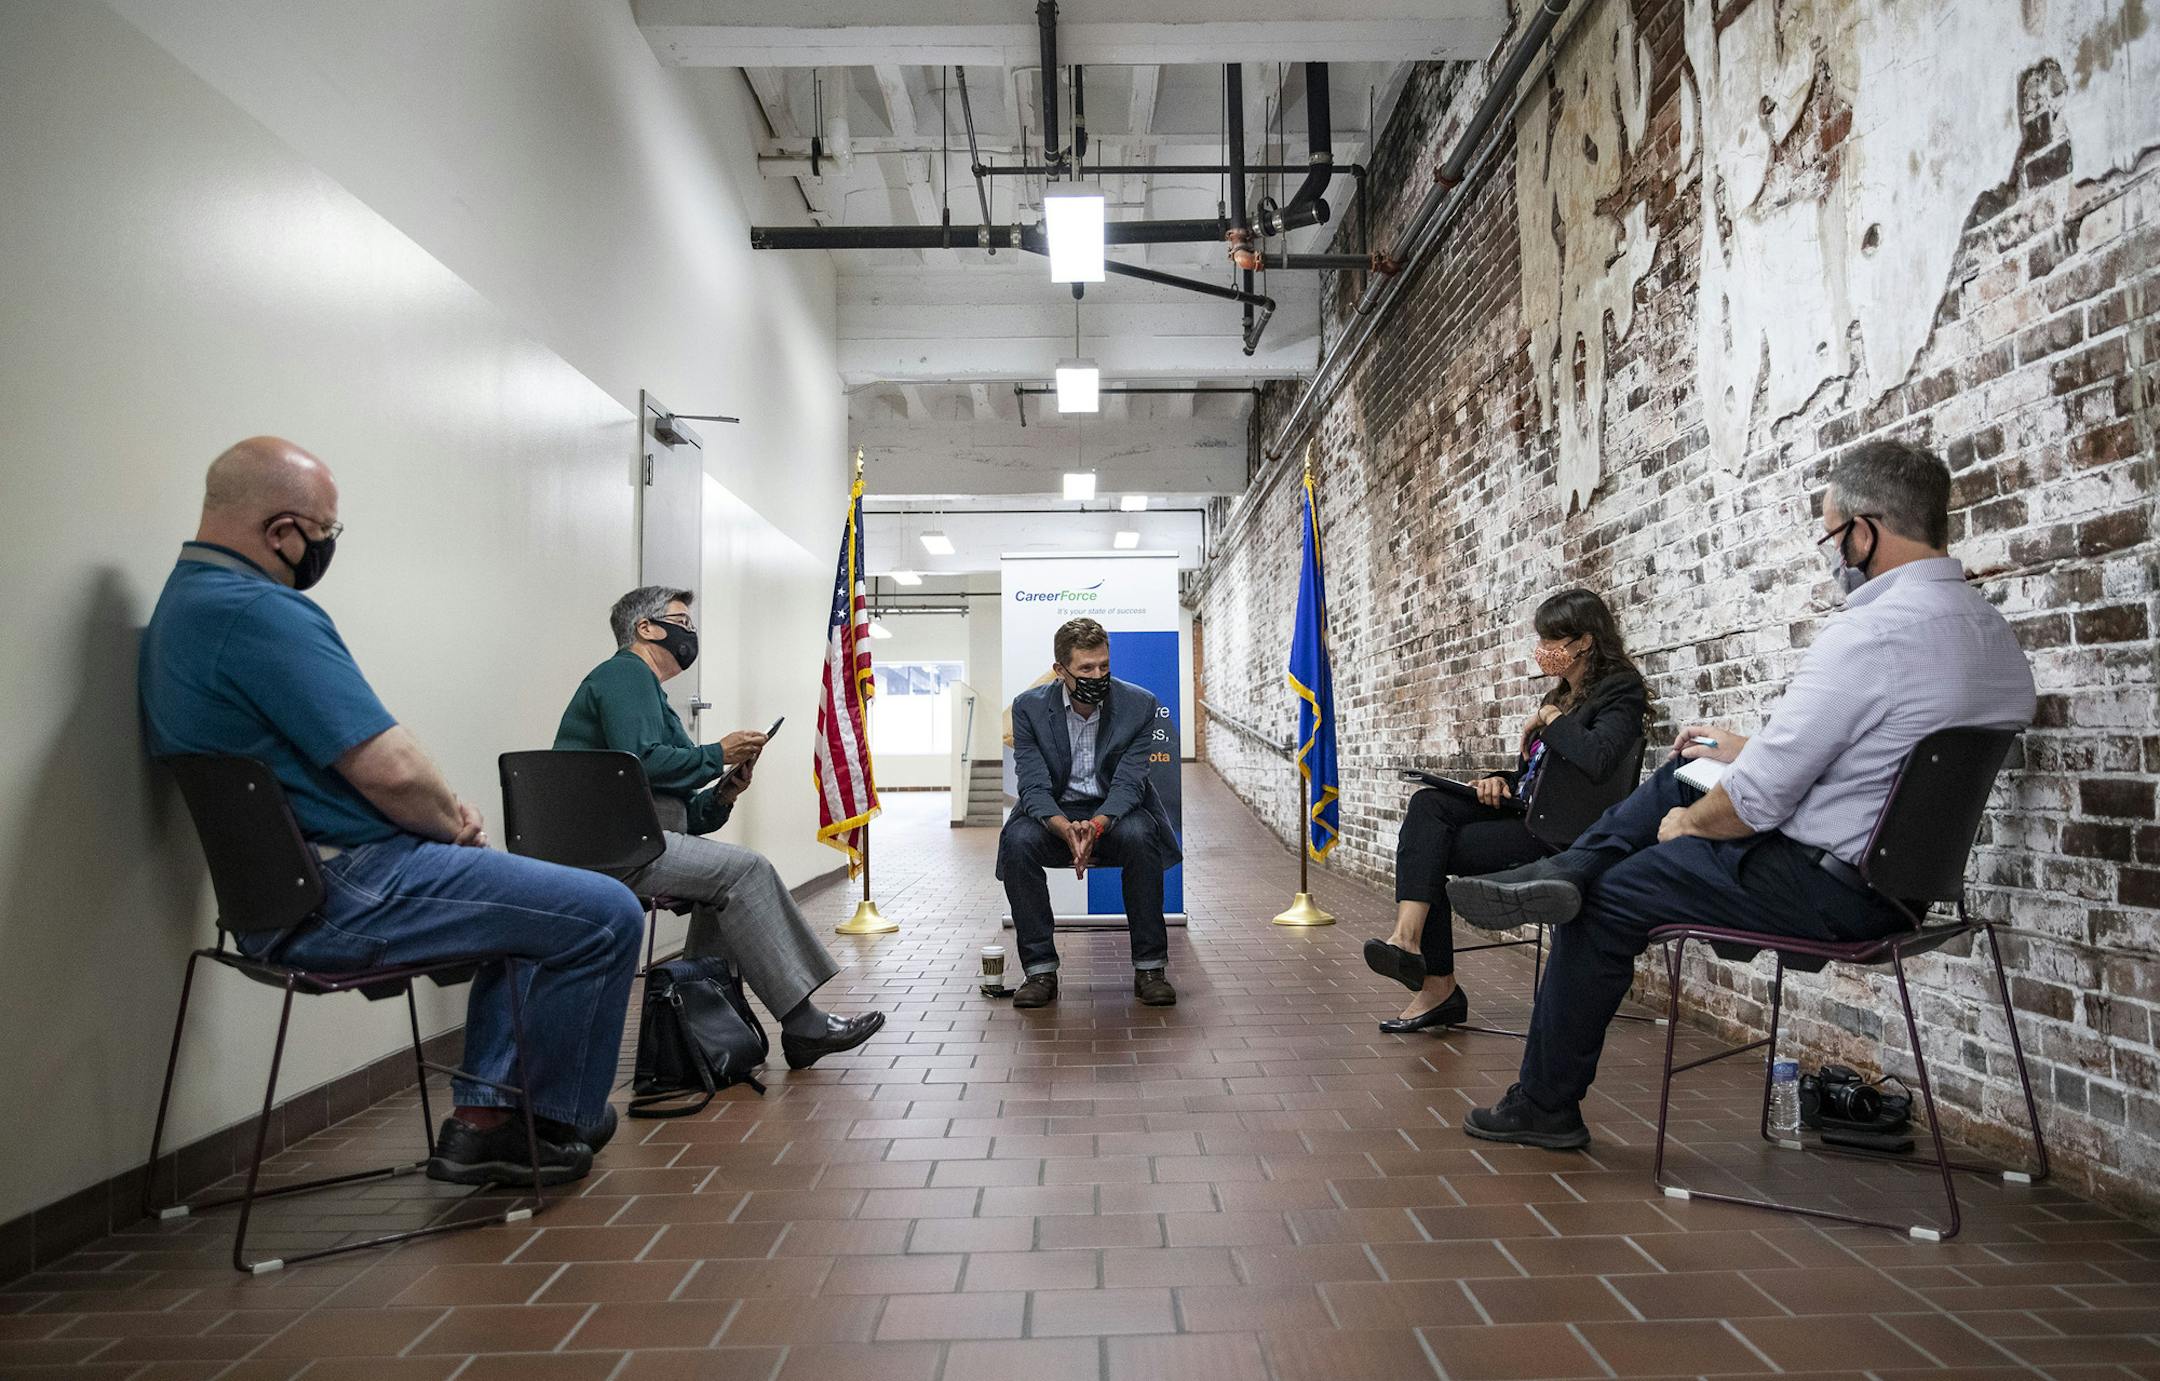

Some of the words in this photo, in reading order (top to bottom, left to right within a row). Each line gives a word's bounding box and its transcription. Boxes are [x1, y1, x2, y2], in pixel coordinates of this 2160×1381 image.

[1015, 590, 1097, 602] CareerForce
[1070, 609, 1086, 617] your
[1088, 607, 1106, 615] state
[1108, 607, 1116, 615] of
[1117, 607, 1146, 615] success
